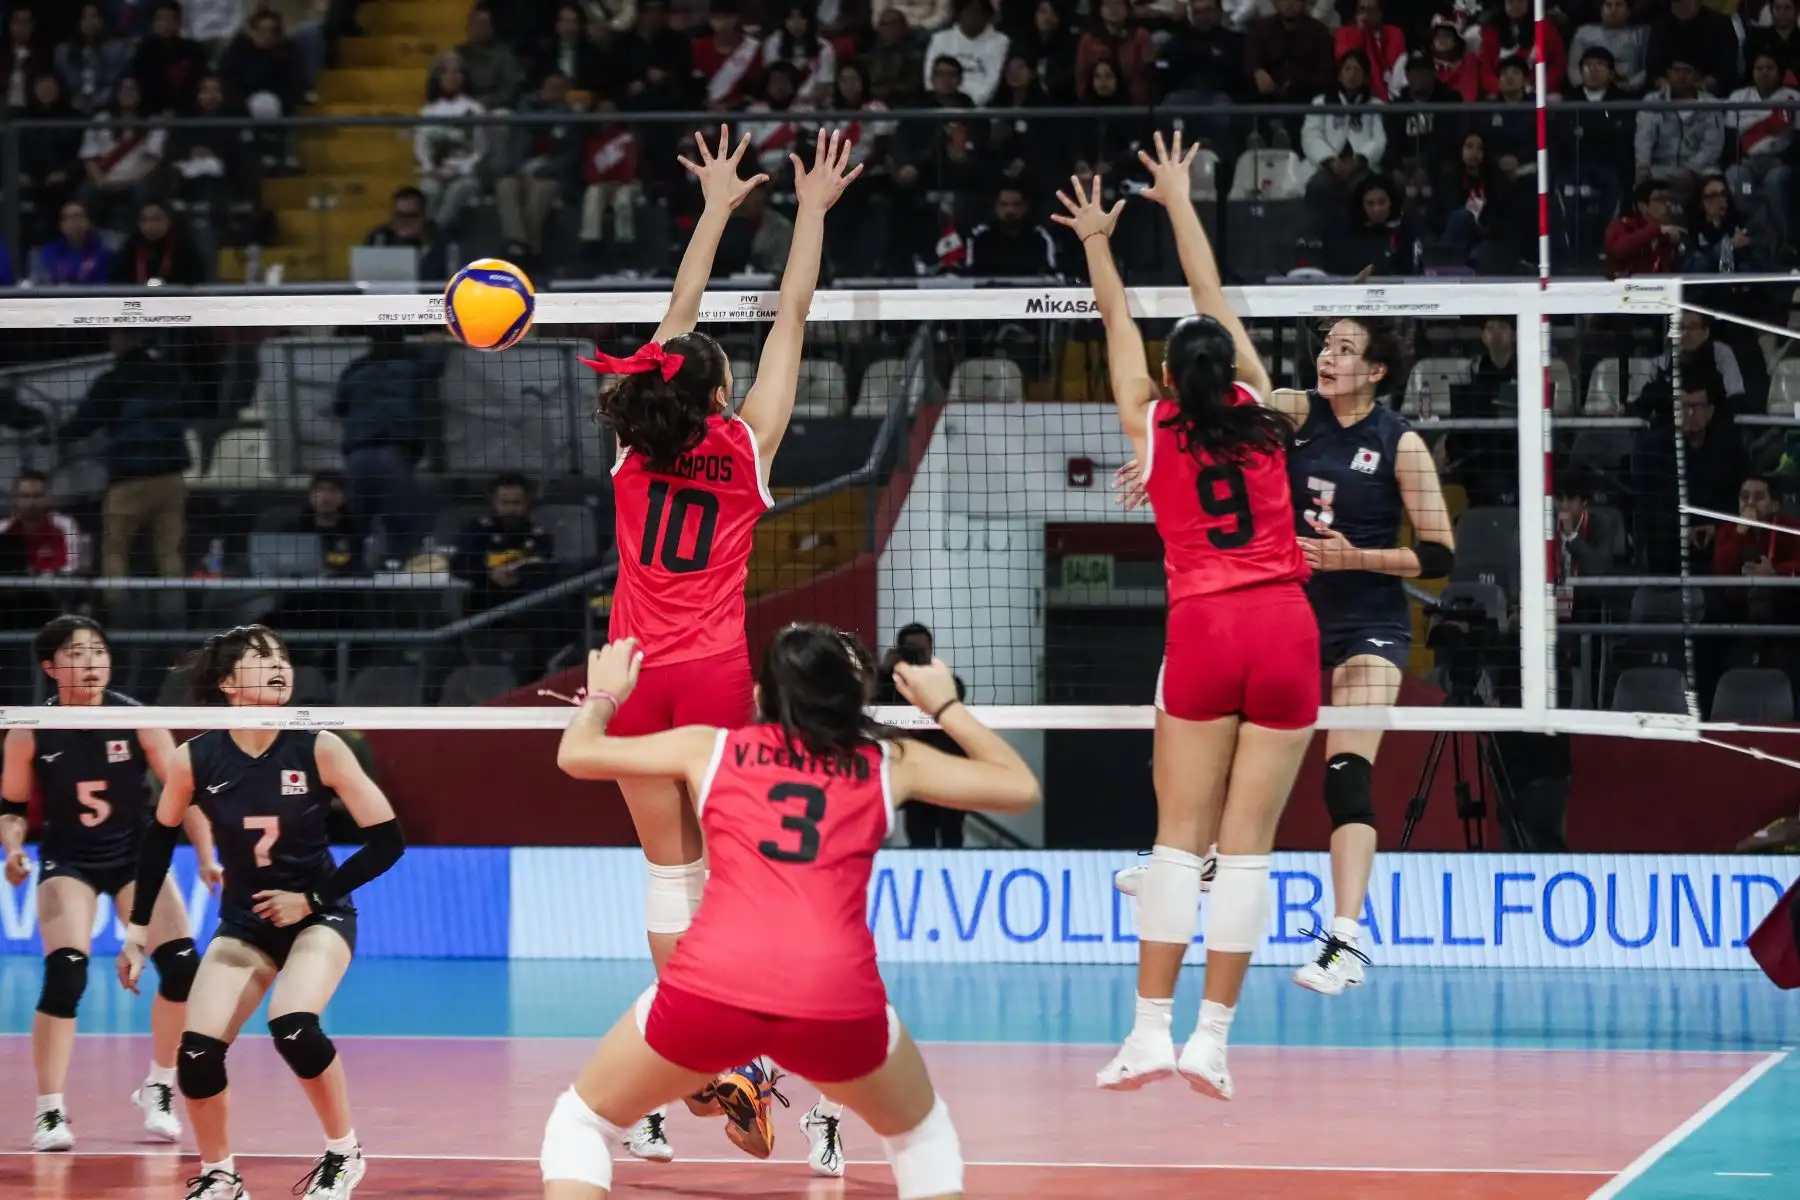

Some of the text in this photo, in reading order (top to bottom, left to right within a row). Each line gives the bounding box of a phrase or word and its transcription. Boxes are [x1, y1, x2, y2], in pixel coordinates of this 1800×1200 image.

[729, 310, 754, 318] WORLD
[670, 455, 733, 482] MPOS
[640, 481, 719, 574] 10
[1197, 464, 1254, 549] 9
[1303, 476, 1336, 533] 3
[76, 780, 111, 827] 5
[759, 781, 826, 863] 3
[243, 816, 280, 868] 7
